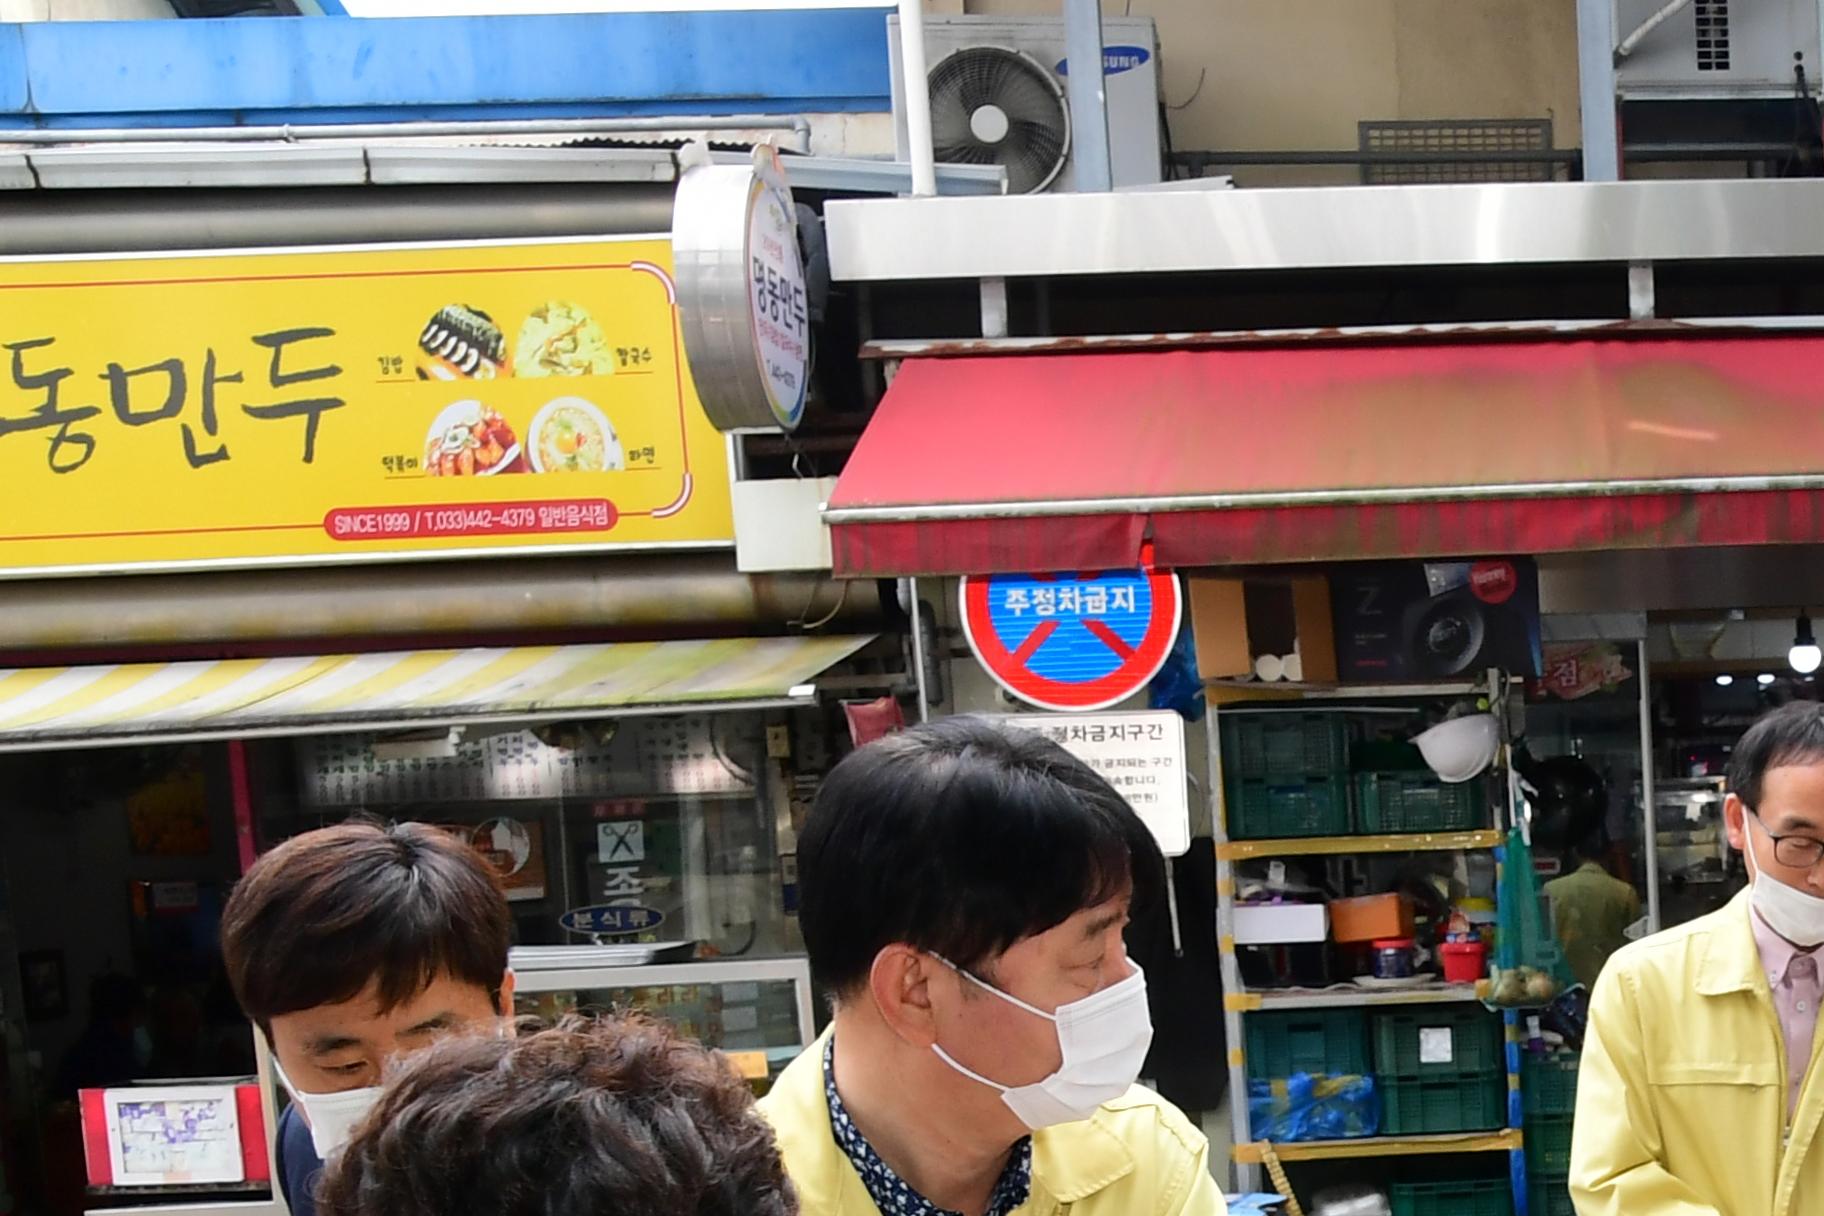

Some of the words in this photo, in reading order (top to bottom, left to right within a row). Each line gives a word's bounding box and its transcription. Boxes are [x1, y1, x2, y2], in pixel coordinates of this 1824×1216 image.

[377, 354, 404, 376] 김밥
[615, 346, 652, 367] 칼국수
[381, 454, 418, 471] 떡볶이
[629, 446, 656, 466] 라면
[334, 511, 410, 535] SINCE1999
[538, 501, 609, 528] 일반음식점
[1004, 585, 1136, 616] 주정차금지
[1044, 723, 1164, 743] 정차금지구간
[1150, 756, 1173, 768] 구간
